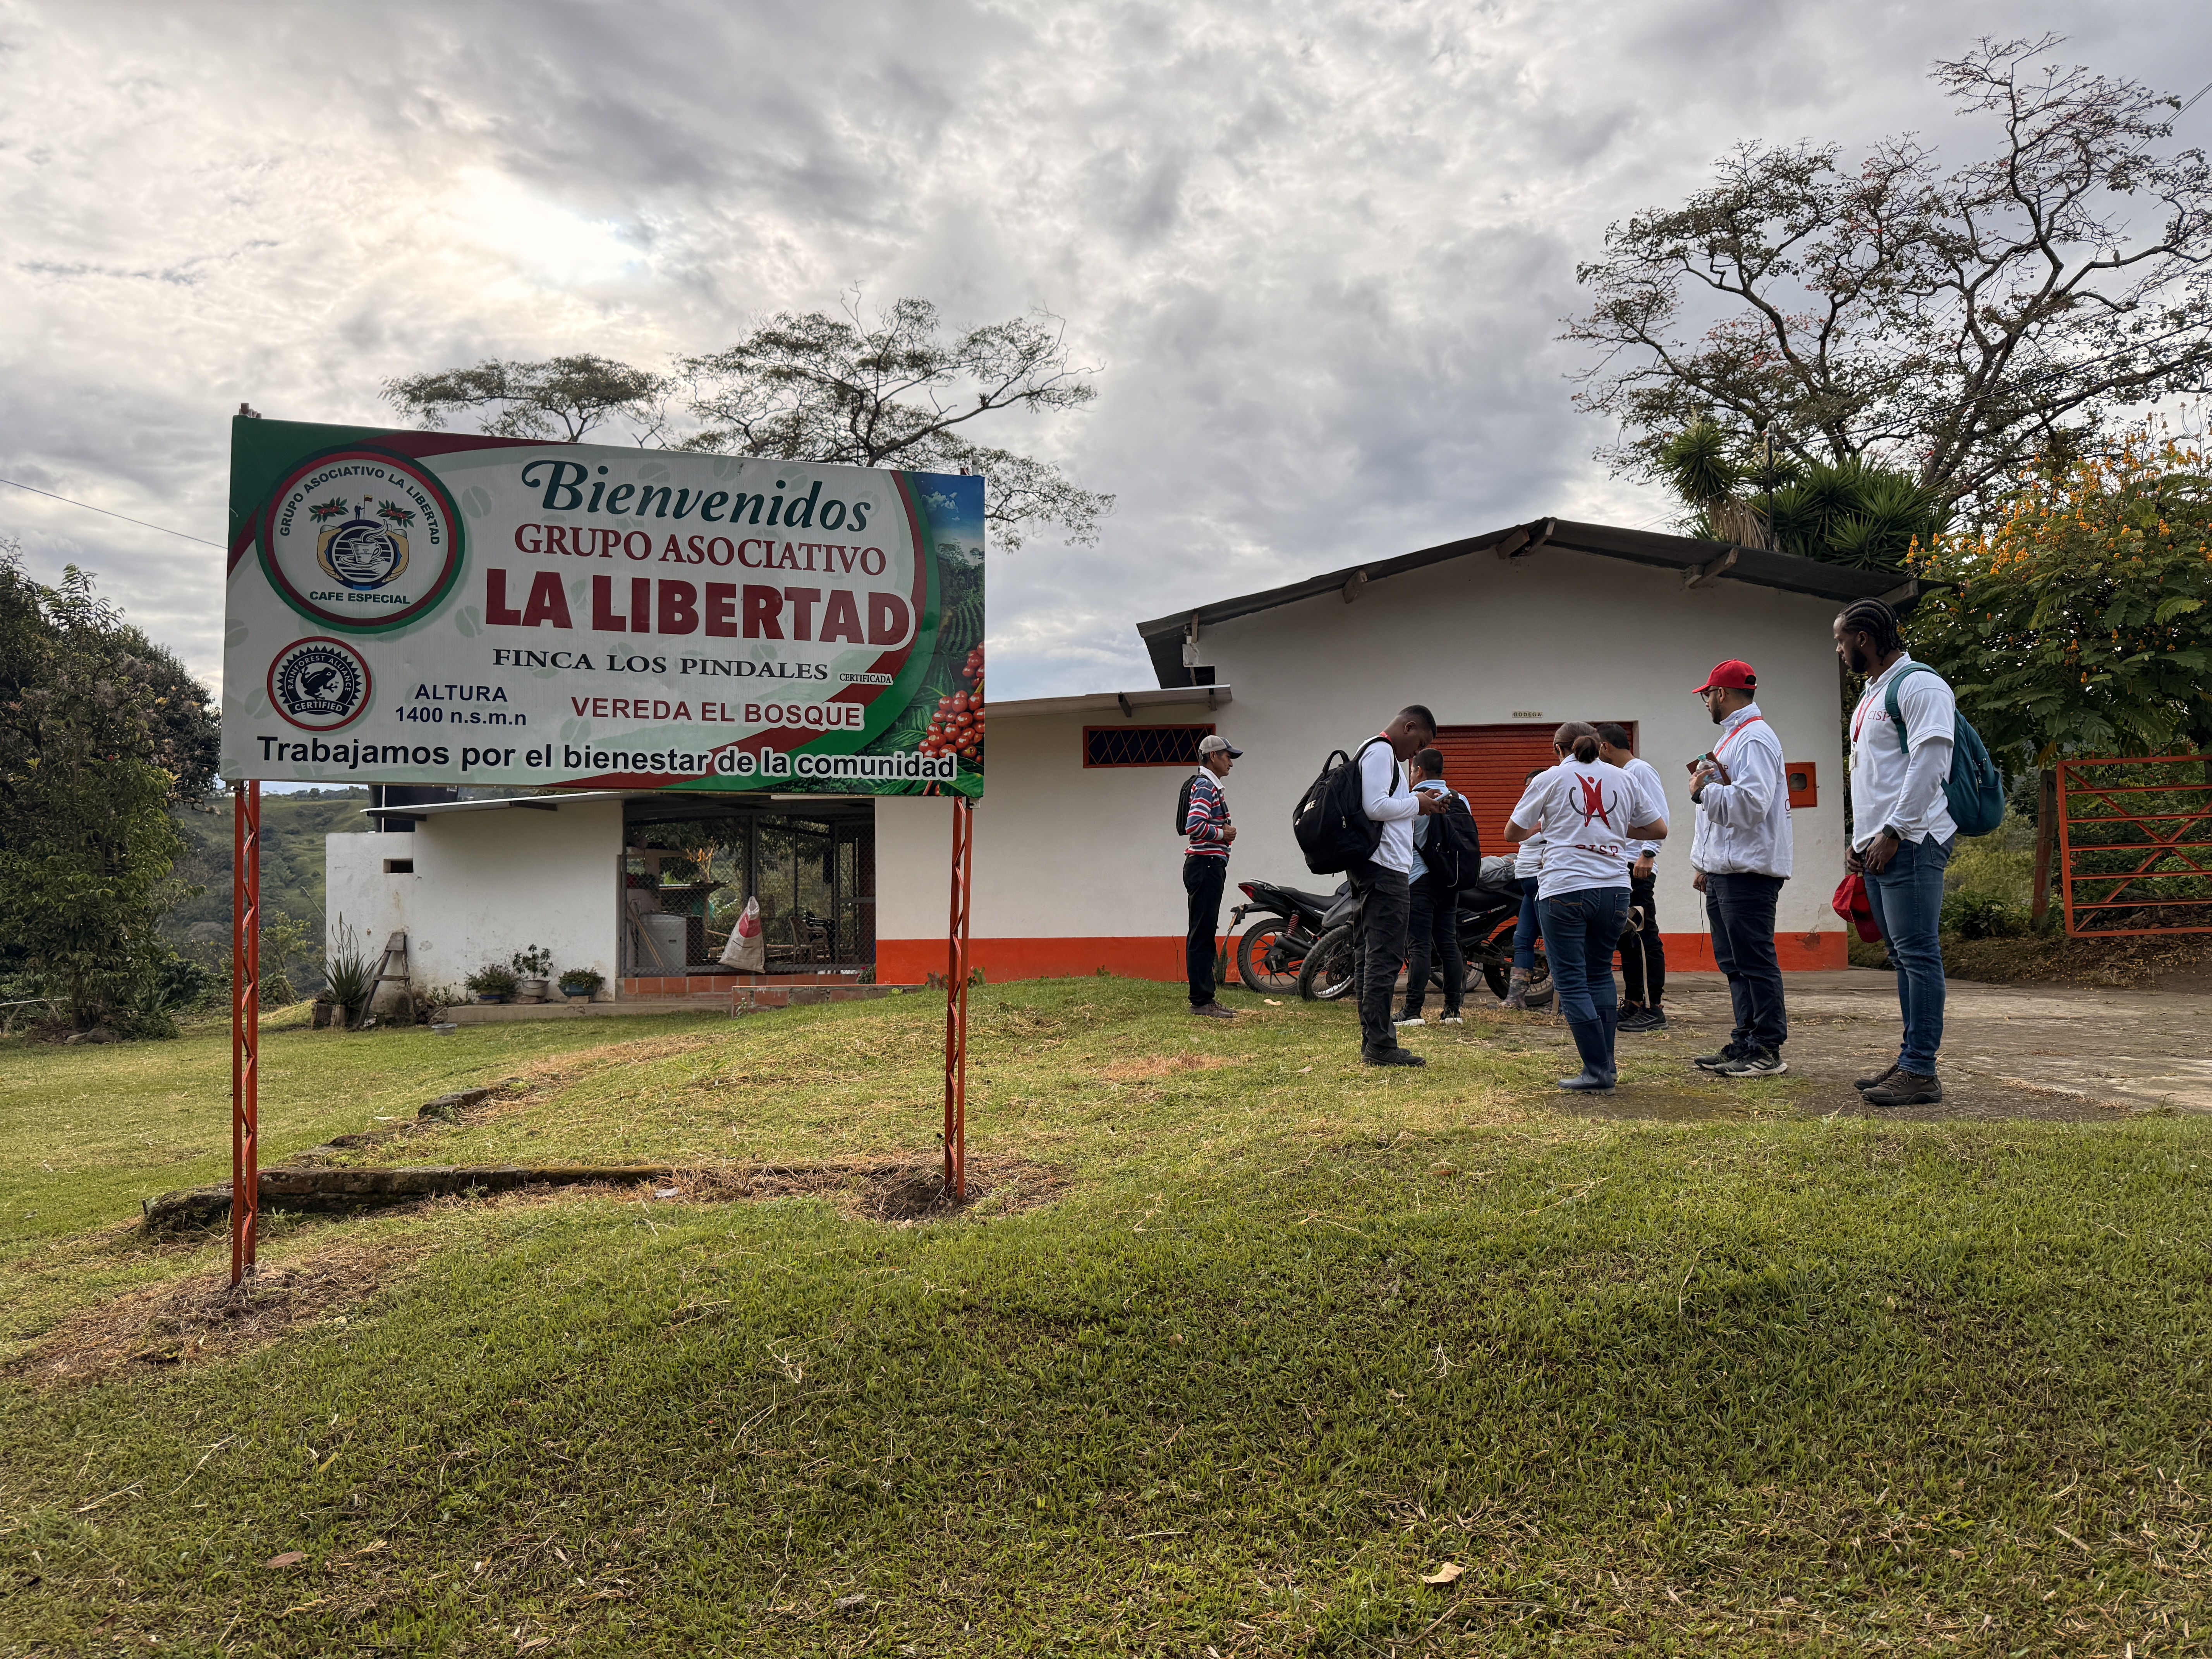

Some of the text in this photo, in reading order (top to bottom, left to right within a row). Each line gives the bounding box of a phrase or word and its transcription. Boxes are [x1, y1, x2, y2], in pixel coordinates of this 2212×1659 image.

[280, 466, 440, 545] GRUPO ASOCIATIVO LA LIBERTAD
[522, 460, 871, 532] Bienvenidos
[515, 523, 886, 575] GRUPO ASOCIATIVO
[309, 591, 410, 604] CAFE ESPECIAL
[486, 568, 909, 646] LA LIBERTAD
[288, 656, 351, 691] RAINFOREST ALLIANCE
[493, 649, 828, 680] FINCA LOS PINDALES
[840, 673, 891, 683] CERTIFICADA
[295, 701, 343, 711] CERTIFIED
[415, 684, 508, 702] ALTURA
[395, 706, 527, 726] 1400 n.s.m.n
[571, 697, 860, 726] VEREDA EL BOSQUE
[1868, 710, 1891, 721] CISP
[257, 736, 953, 778] Trabajamos por el bienestar de la comunidad
